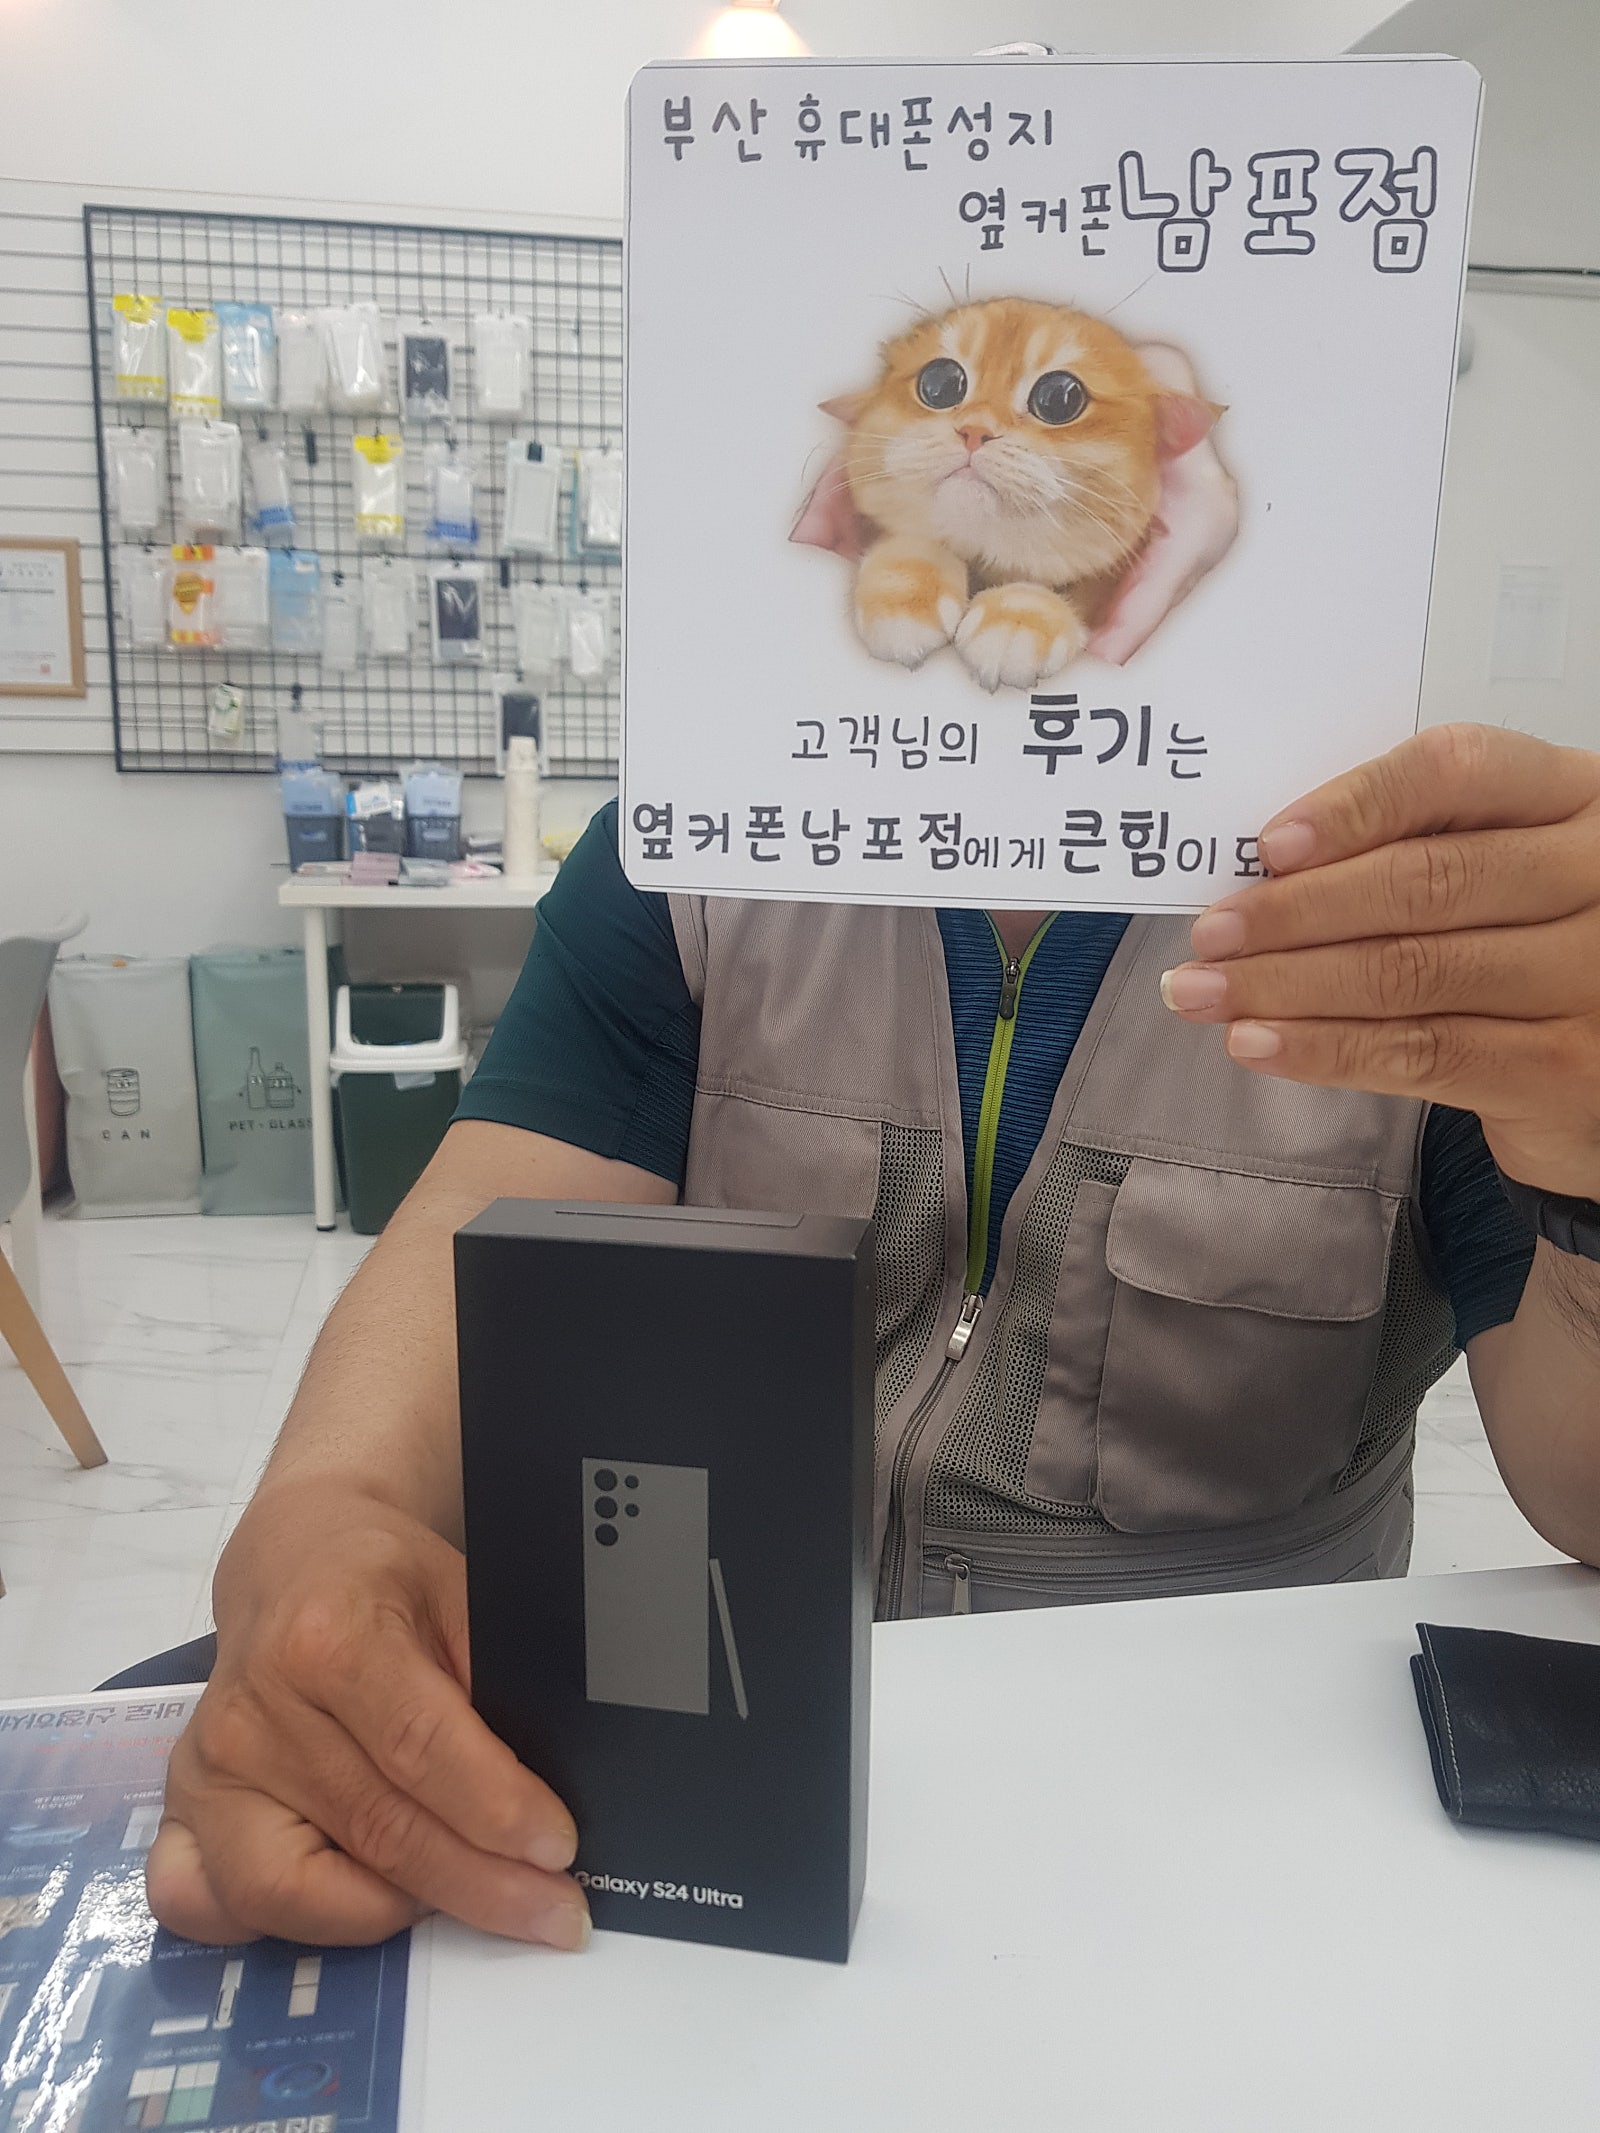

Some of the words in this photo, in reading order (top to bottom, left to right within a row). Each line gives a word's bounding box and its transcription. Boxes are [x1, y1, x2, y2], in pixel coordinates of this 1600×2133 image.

[664, 95, 767, 163] 부산
[794, 93, 1053, 171] 휴대폰성지
[791, 714, 978, 771] 고객님의
[1022, 693, 1208, 779] 후기는
[102, 1128, 150, 1140] CAN
[574, 1870, 650, 1900] Galaxy
[652, 1880, 690, 1902] S24
[692, 1885, 744, 1910] Ultra
